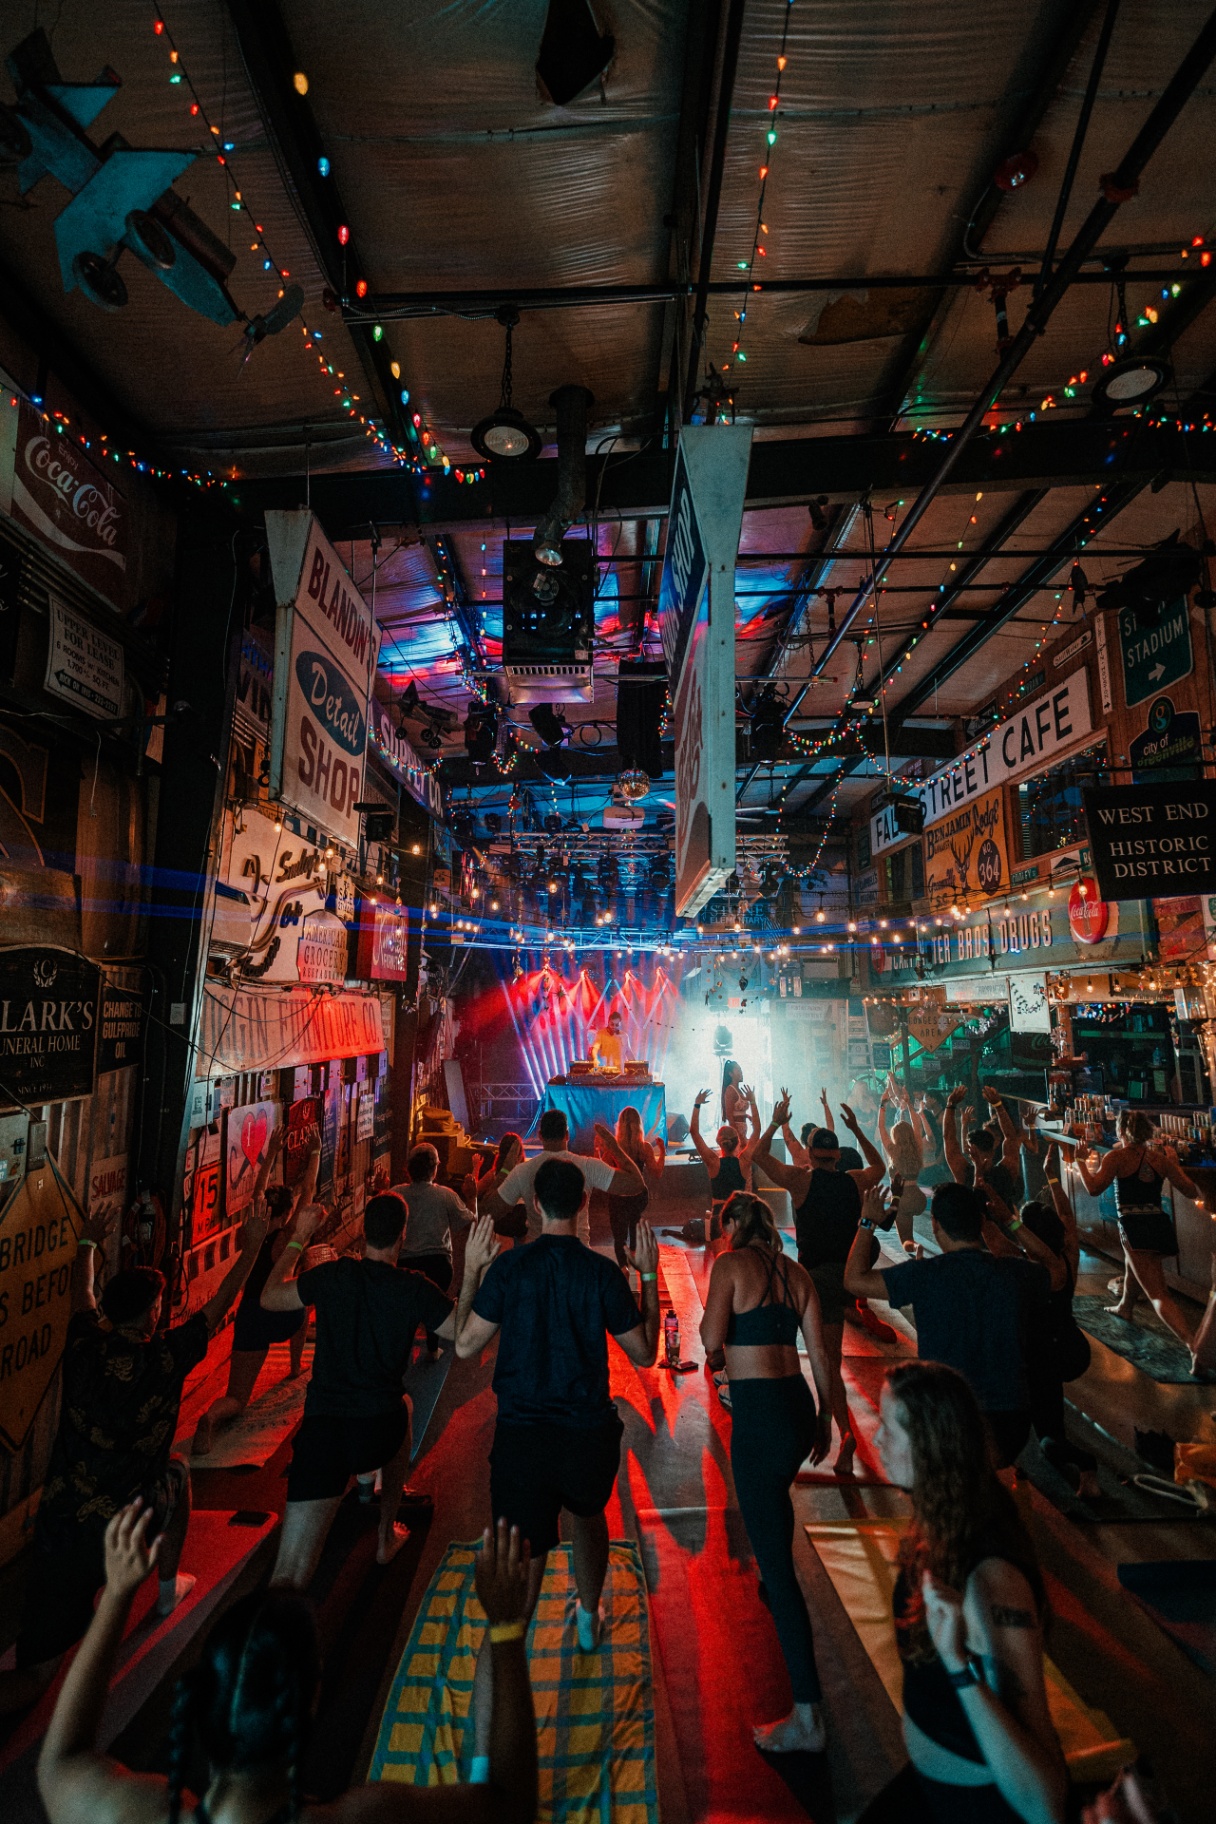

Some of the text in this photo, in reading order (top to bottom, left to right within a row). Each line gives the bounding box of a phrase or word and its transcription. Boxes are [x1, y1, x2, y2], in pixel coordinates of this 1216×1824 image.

[25, 436, 121, 545] Coca-Cola
[56, 608, 88, 640] UPPER
[307, 547, 377, 680] BLANDIN'S
[64, 628, 114, 671] FOR LEASE
[1127, 614, 1184, 668] STADIUM
[310, 661, 359, 748] Detail
[1143, 733, 1169, 756] city of
[299, 715, 361, 819] SHOP
[876, 808, 900, 848] FAL
[919, 741, 990, 821] STREET
[1002, 687, 1072, 768] CAFE
[927, 799, 998, 861] BENJAMIN Lodge
[1097, 802, 1209, 825] WEST END
[1109, 835, 1209, 857] HISTORIC
[979, 854, 999, 886] 364
[1113, 857, 1211, 878] DISTRICT
[305, 923, 346, 949] AMERICAN
[957, 924, 995, 961] BROS.
[1000, 909, 1052, 954] DRUGS
[304, 945, 345, 970] GROCERY
[0, 1000, 93, 1033] LARK'S
[103, 1001, 133, 1019] CHANGE
[278, 996, 360, 1052] FURNITURE
[362, 1002, 379, 1044] CO.
[0, 1034, 81, 1056] UNERAL HOME
[102, 1022, 140, 1040] GULFPRIDE
[30, 1055, 45, 1069] INC
[115, 1041, 126, 1059] OIL
[91, 1167, 126, 1199] SALVAGE
[199, 1173, 218, 1214] 15
[0, 1215, 70, 1271] BRIDGE
[21, 1261, 75, 1318] BEFO
[0, 1323, 51, 1382] ROAD
